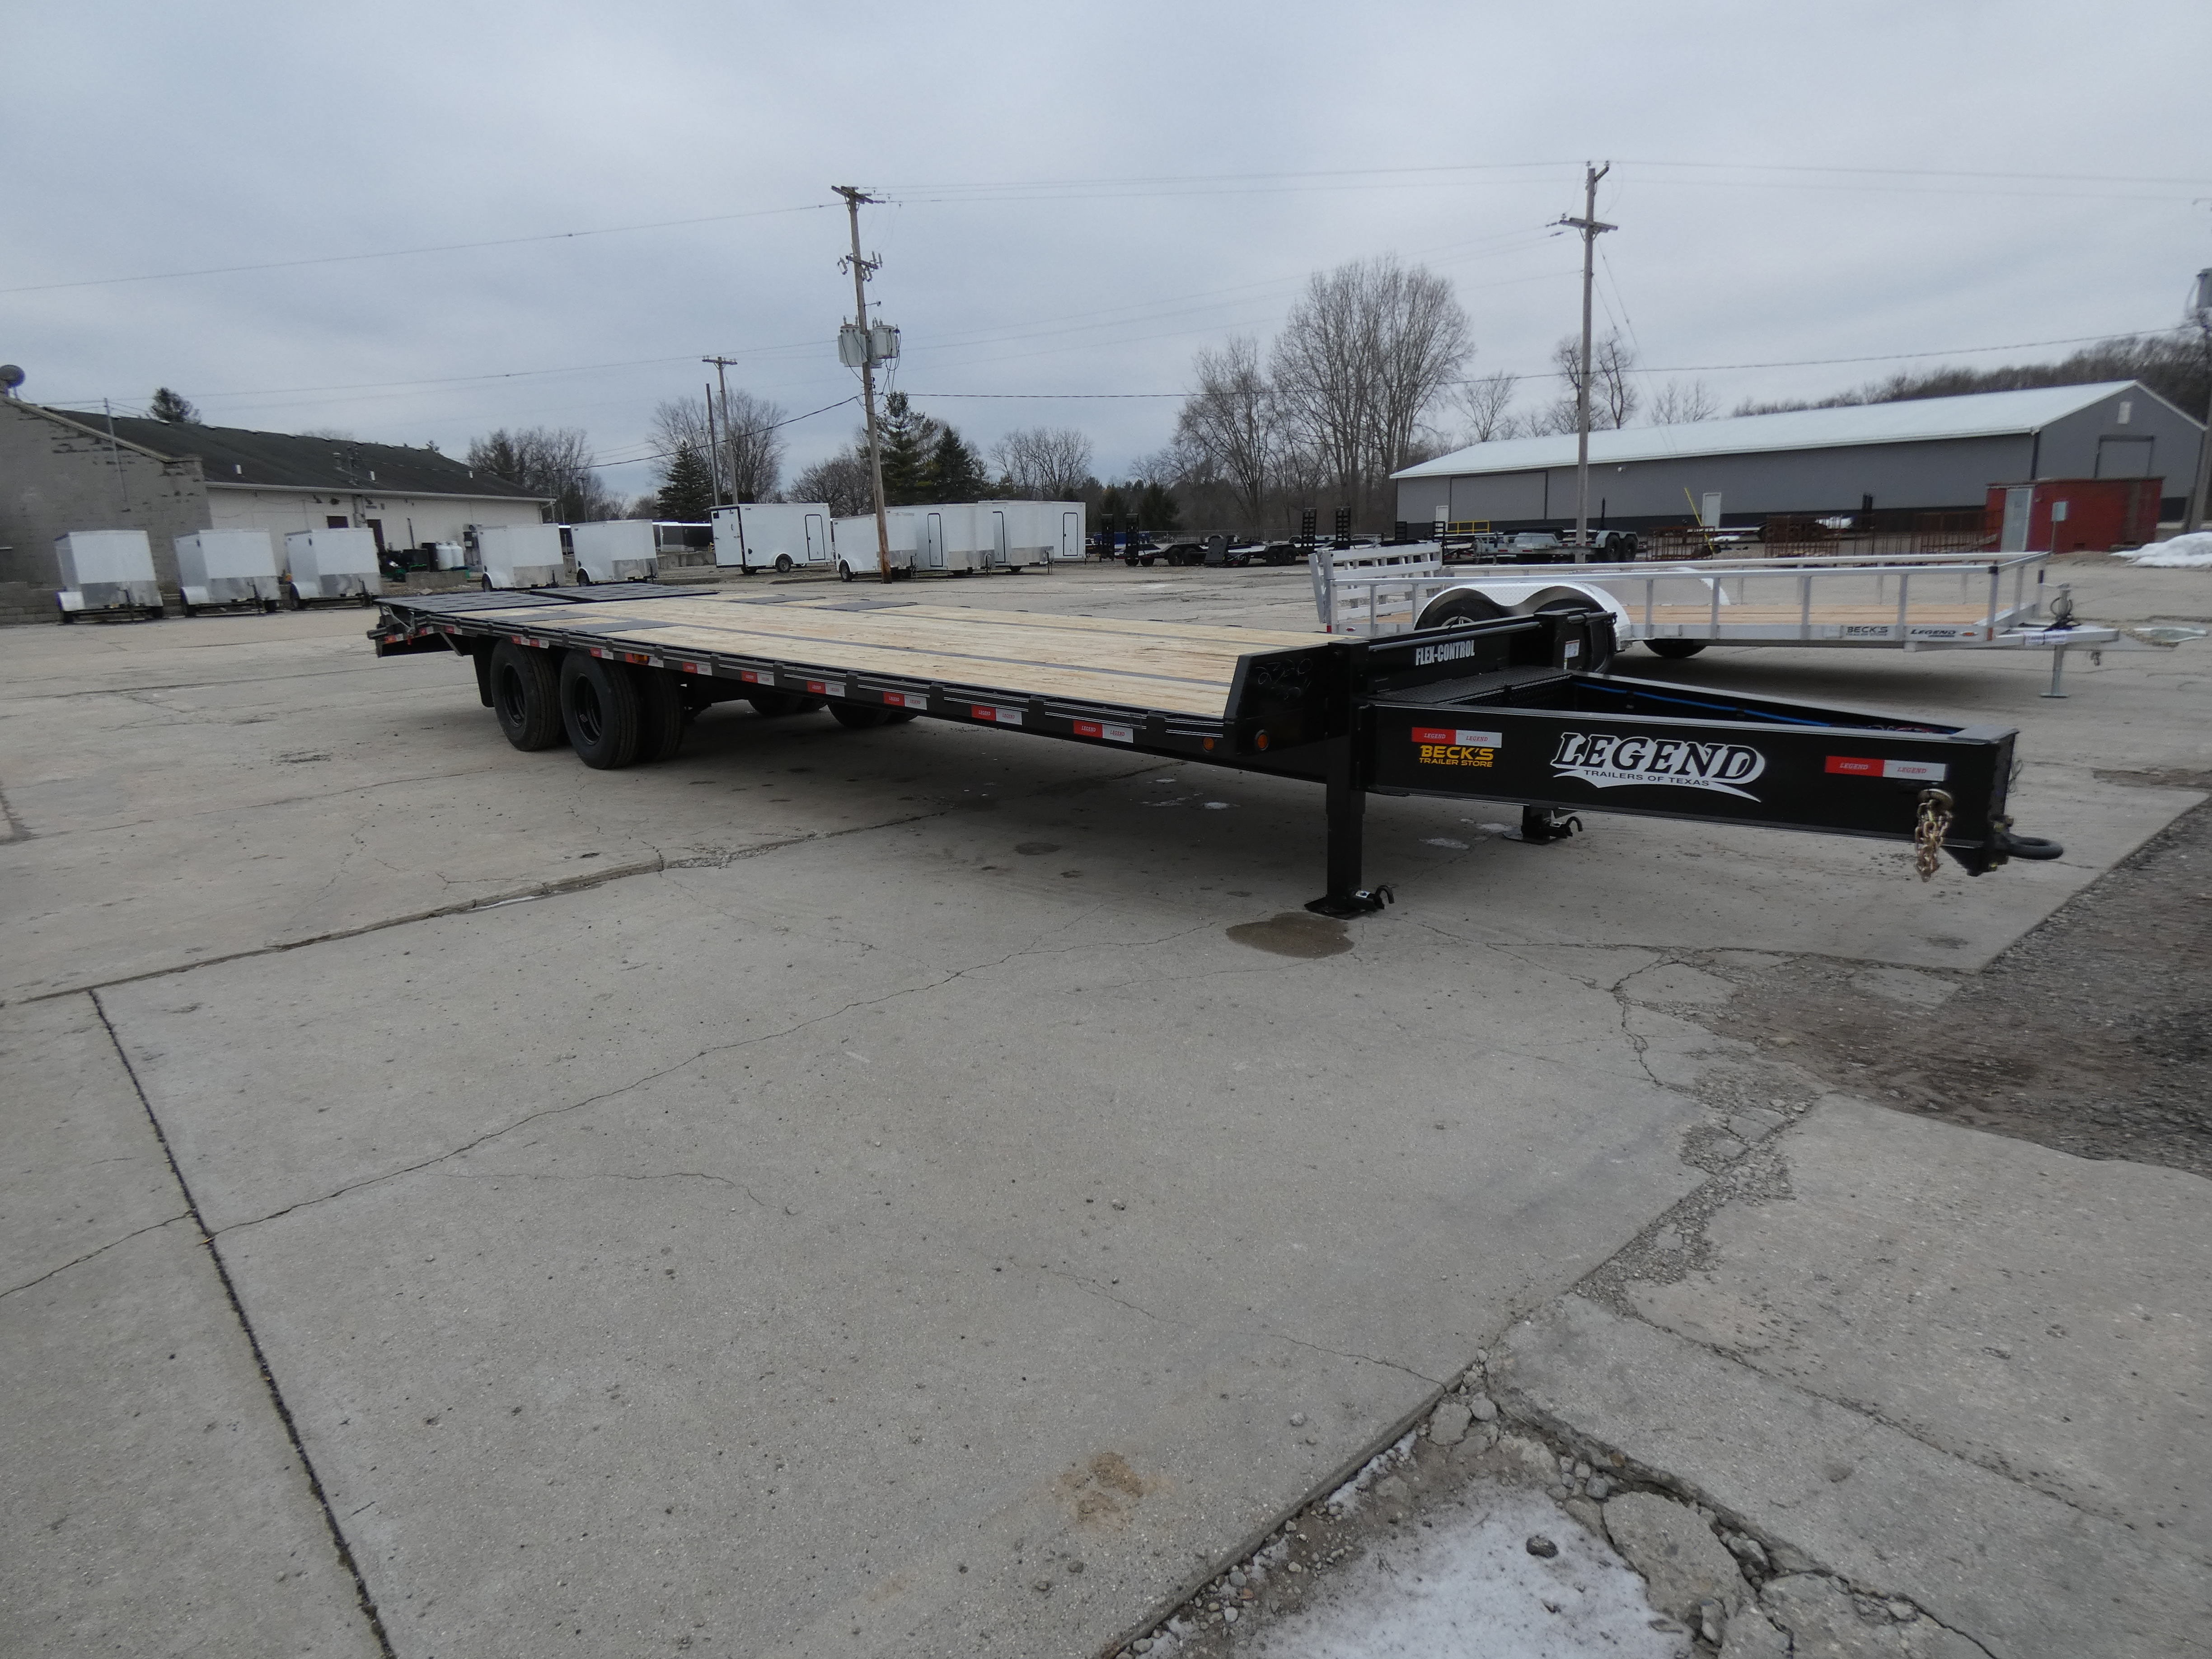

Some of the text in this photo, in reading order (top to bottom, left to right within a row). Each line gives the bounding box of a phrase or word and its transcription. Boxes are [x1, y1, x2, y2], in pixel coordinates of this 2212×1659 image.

[1415, 640, 1475, 665] FLEX-CONTROL
[1420, 745, 1494, 761] BECK'S
[1550, 732, 1764, 783] LEGEND
[1839, 762, 1869, 770] LEGEND
[1584, 769, 1643, 780] TRAILERS
[1668, 777, 1710, 787] TEXAS
